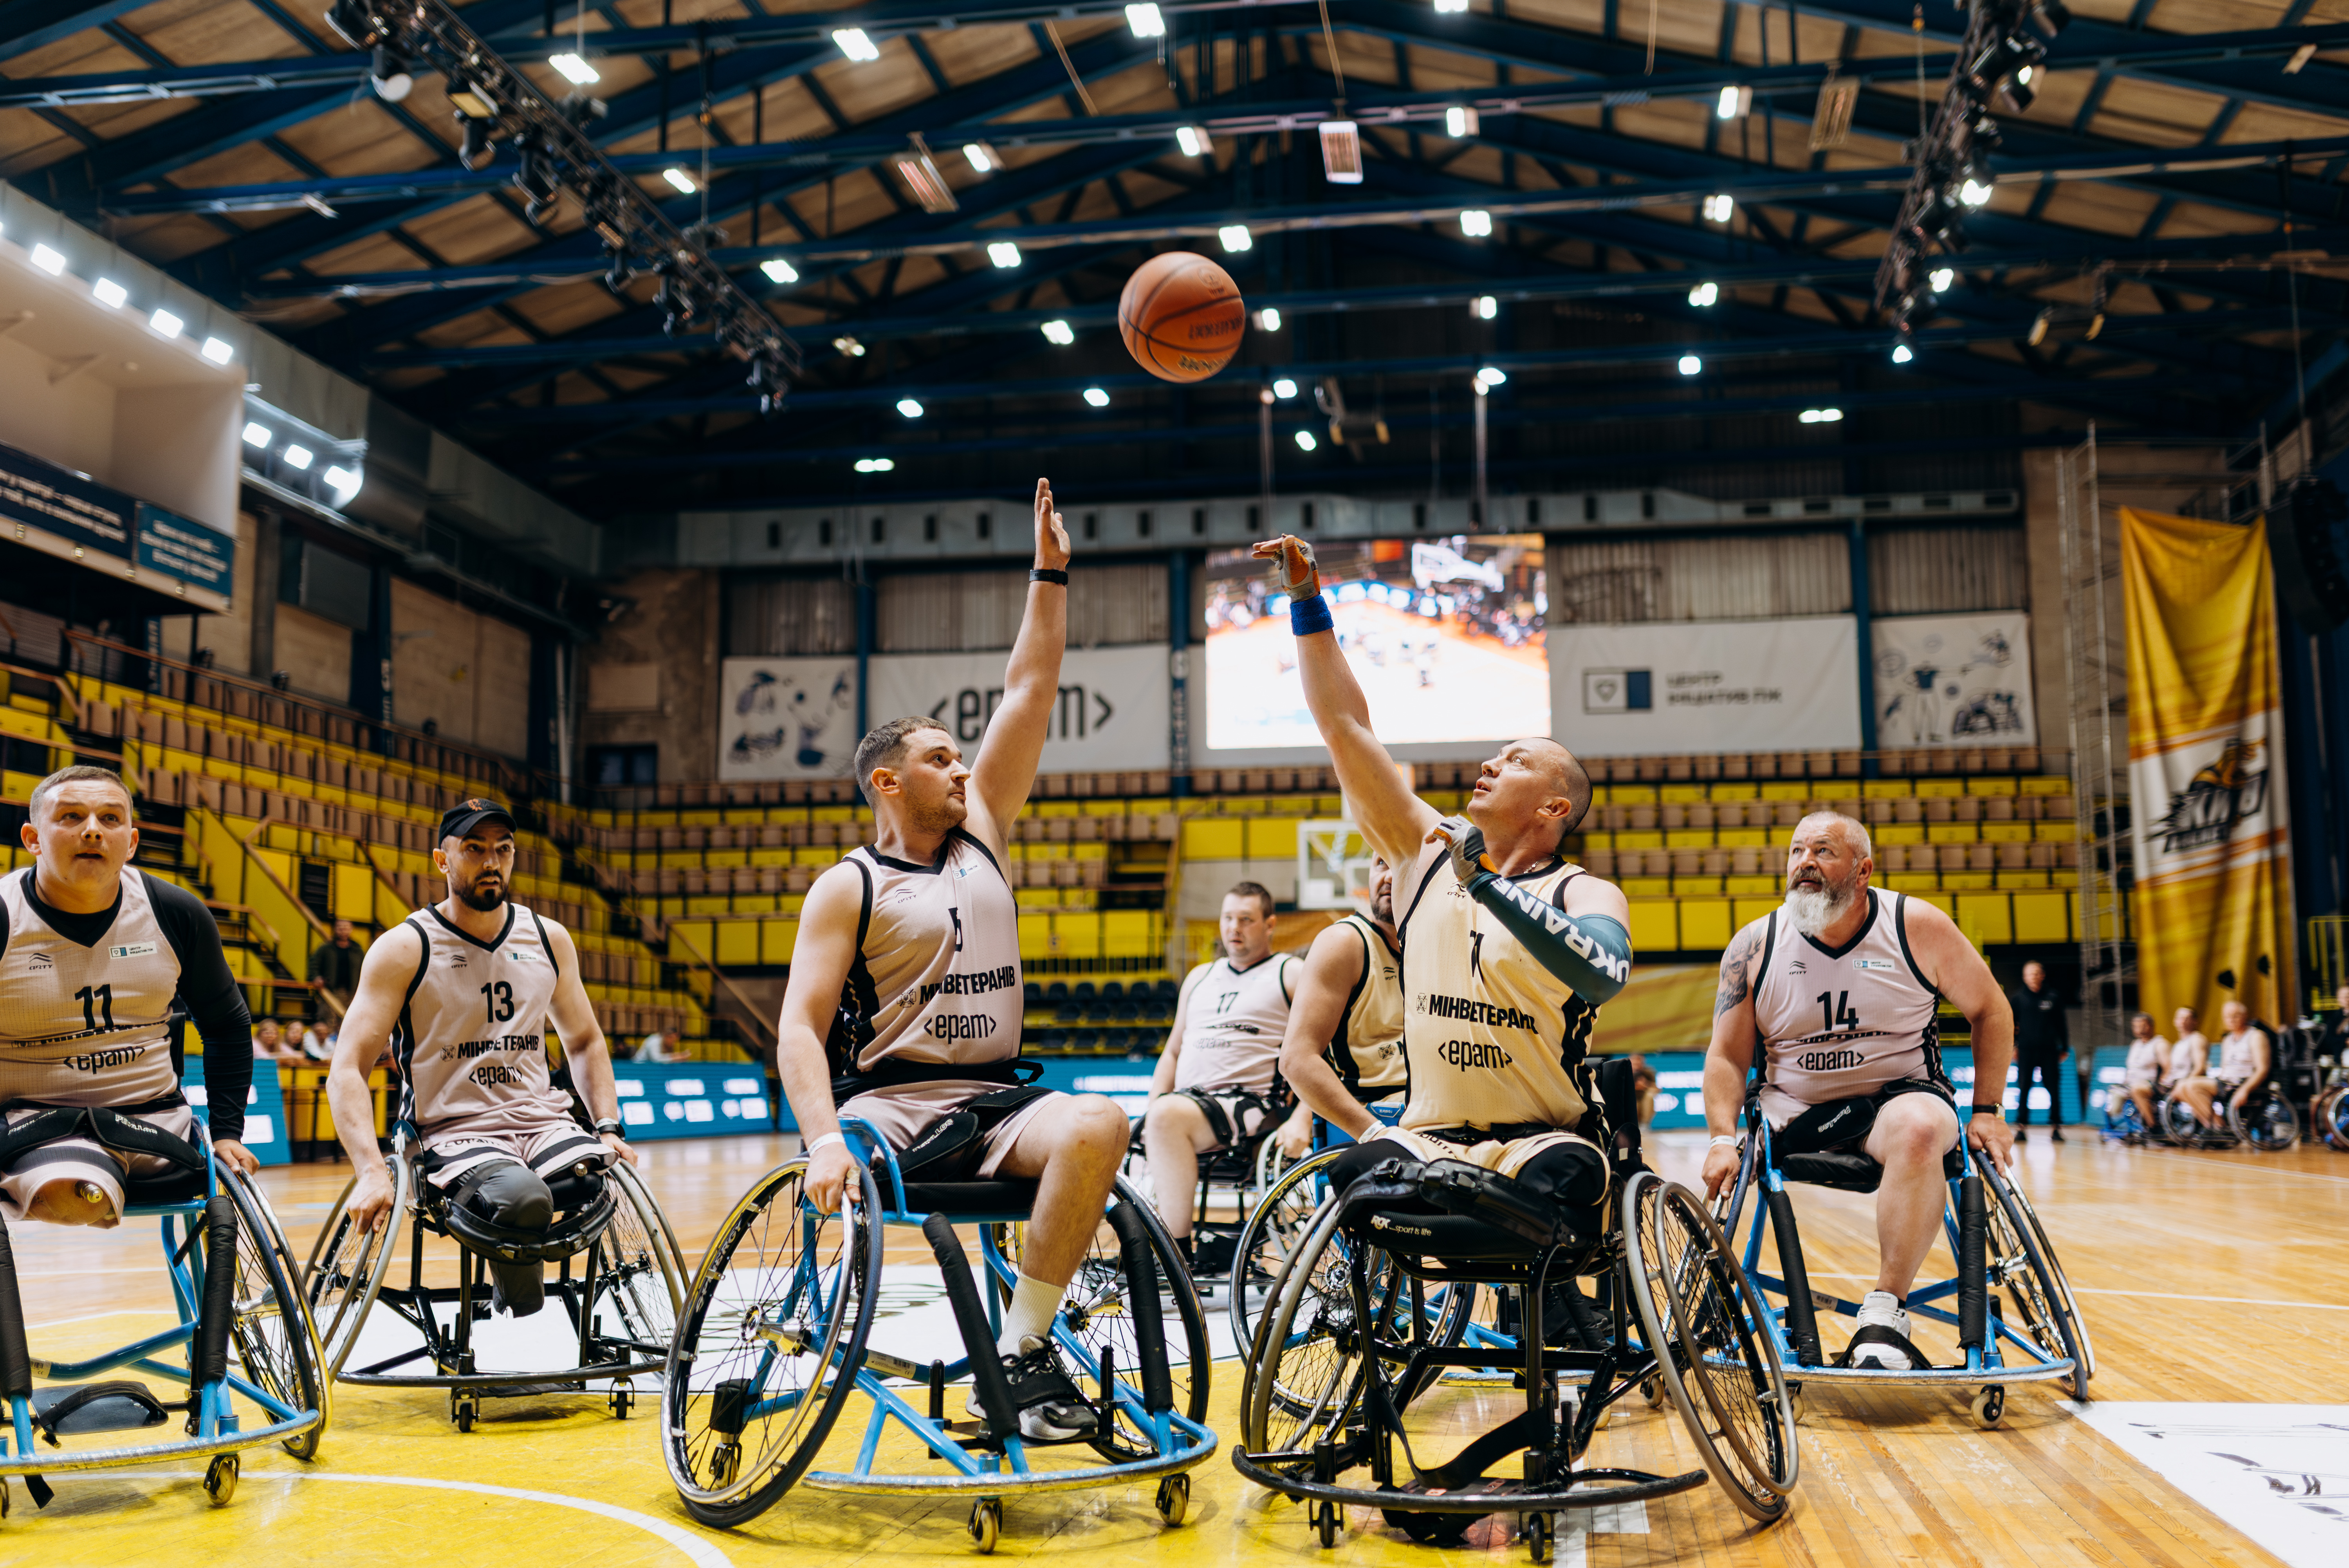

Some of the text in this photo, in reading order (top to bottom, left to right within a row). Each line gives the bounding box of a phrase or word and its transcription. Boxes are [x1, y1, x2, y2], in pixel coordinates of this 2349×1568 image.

[1490, 877, 1630, 983] UKRAINE
[75, 983, 114, 1030] 11
[480, 981, 515, 1023] 13
[1218, 991, 1239, 1014] 17
[1817, 990, 1859, 1031] 14
[1421, 1227, 1432, 1236] life
